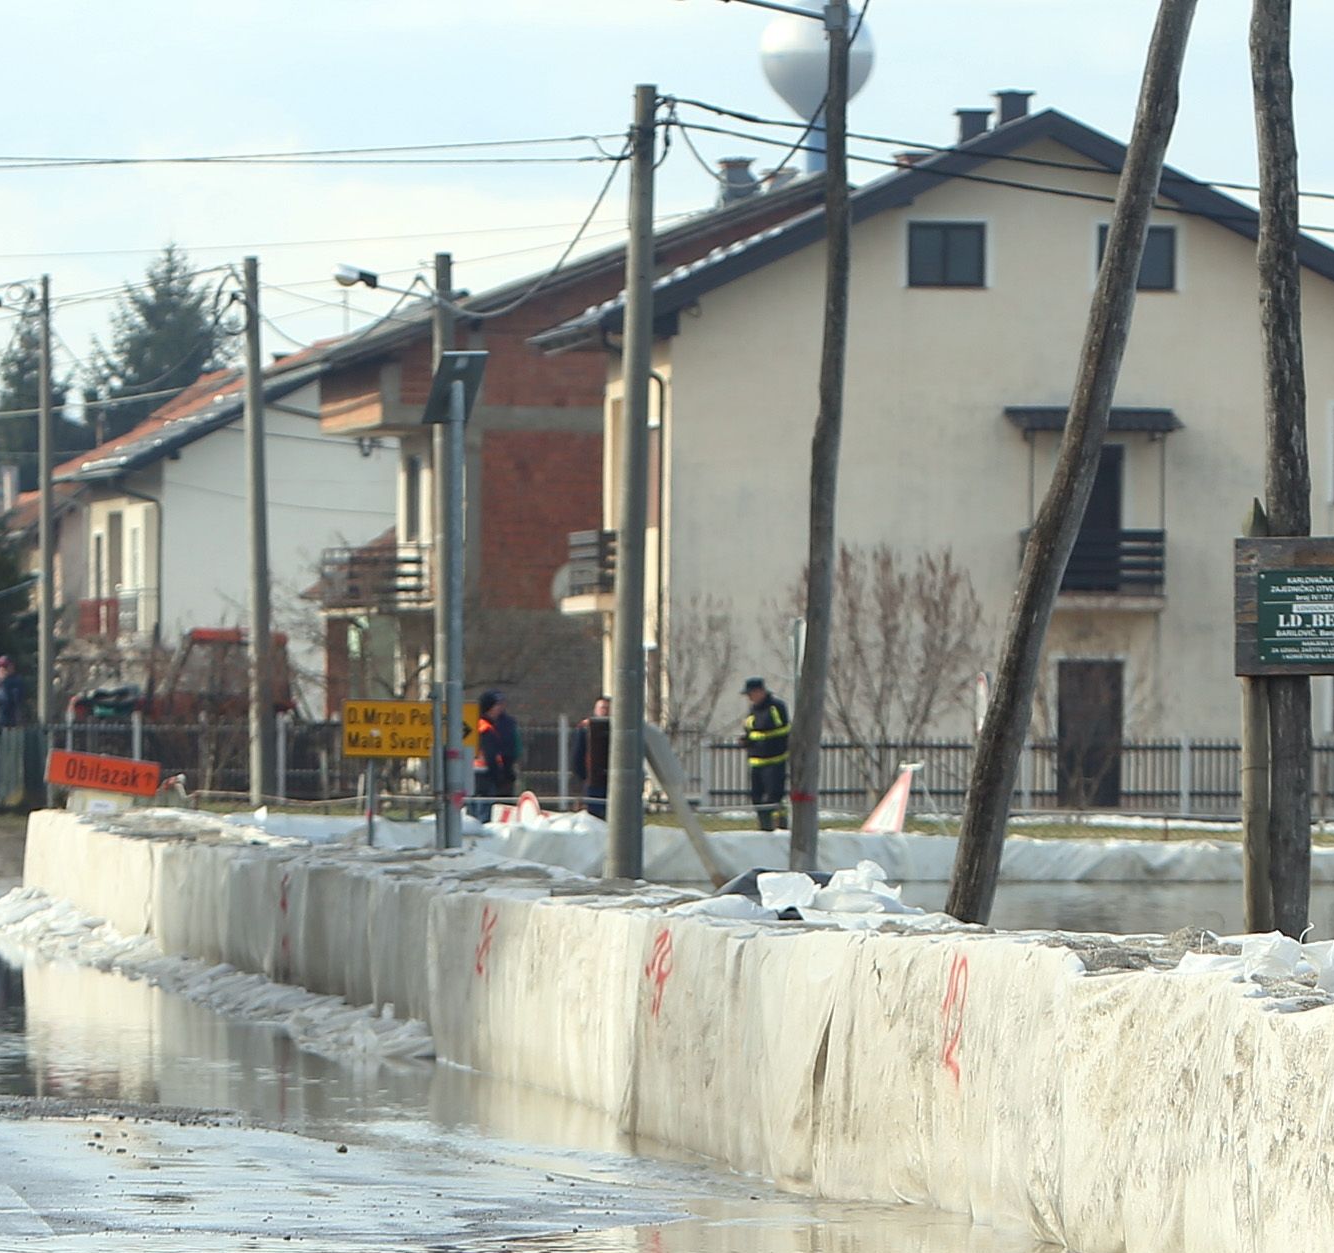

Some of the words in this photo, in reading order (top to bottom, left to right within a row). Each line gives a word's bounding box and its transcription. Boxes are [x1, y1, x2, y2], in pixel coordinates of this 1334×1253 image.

[1278, 614, 1303, 627] LD
[363, 707, 405, 725] Mrzlo
[66, 757, 140, 788] Obilazak
